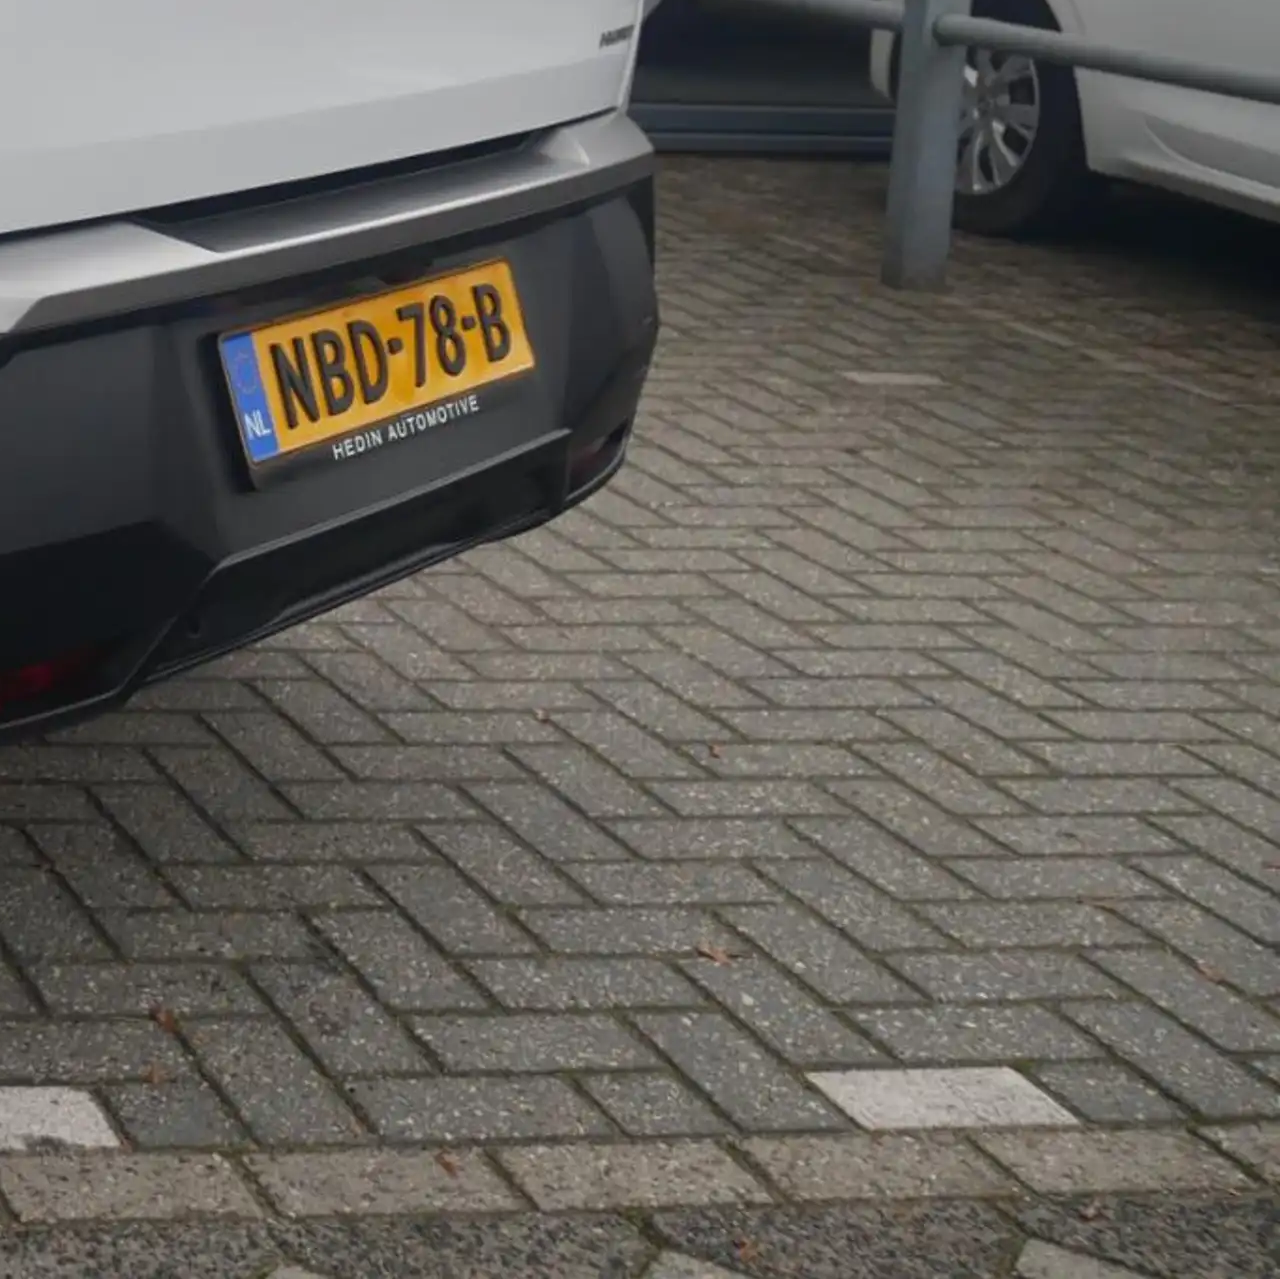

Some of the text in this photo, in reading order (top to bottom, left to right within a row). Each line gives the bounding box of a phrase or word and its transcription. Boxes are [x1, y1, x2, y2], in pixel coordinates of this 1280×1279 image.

[269, 282, 512, 430] NBD-78-B
[243, 408, 272, 441] NL
[331, 394, 481, 461] HEDIN AUTOMOTIVE
